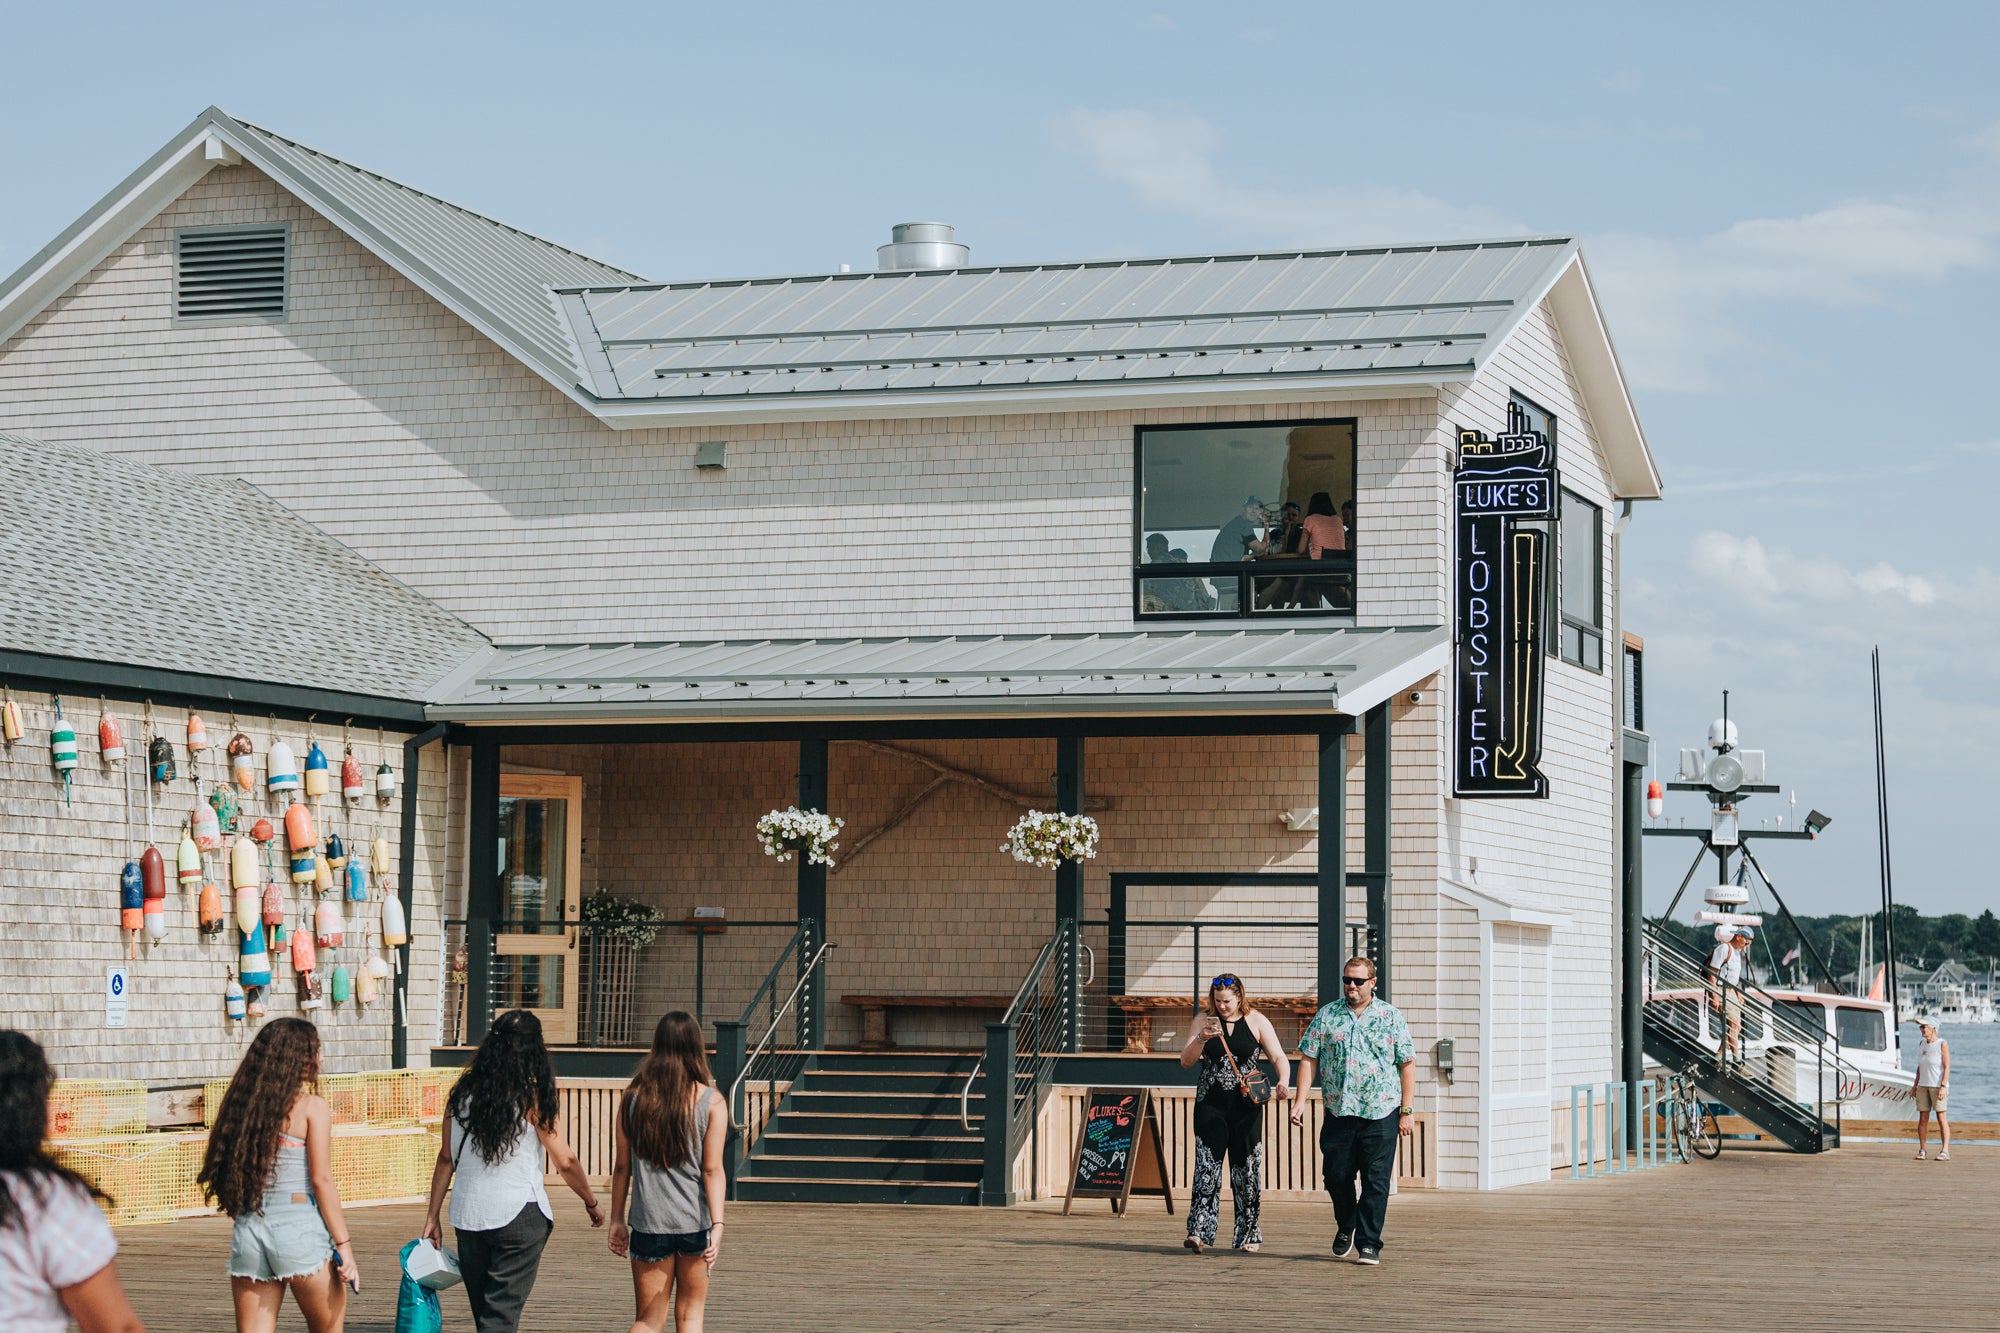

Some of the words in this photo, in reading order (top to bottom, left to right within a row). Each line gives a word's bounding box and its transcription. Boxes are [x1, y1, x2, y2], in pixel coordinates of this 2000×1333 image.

[1465, 483, 1539, 508] LUKE'S
[1469, 523, 1490, 778] LOBSTER
[1095, 1105, 1123, 1117] LUKE'S
[1082, 1148, 1106, 1167] PROSECCO
